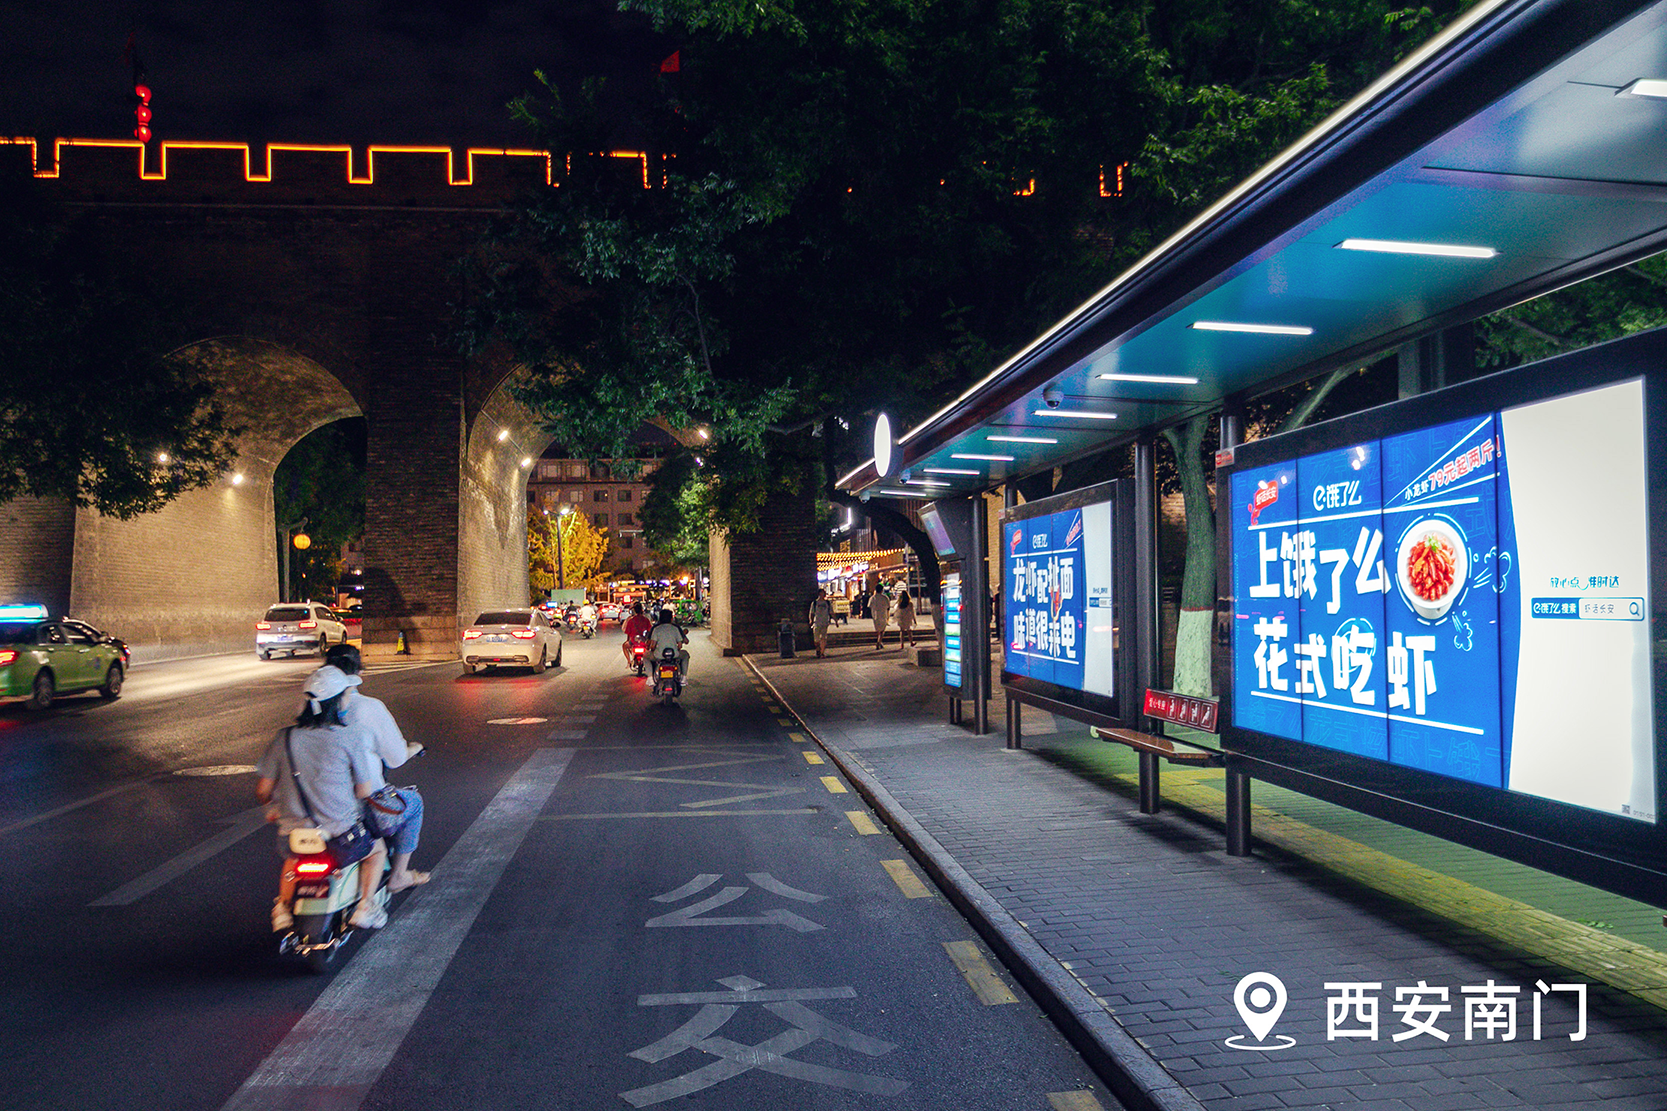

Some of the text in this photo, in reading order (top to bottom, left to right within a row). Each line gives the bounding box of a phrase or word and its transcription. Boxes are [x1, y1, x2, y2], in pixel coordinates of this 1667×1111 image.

[1012, 555, 1074, 604] 龙虾配扯面
[1249, 525, 1391, 615] 上饿了么
[1013, 608, 1077, 659] 味道很来电
[1253, 617, 1438, 717] 花式吃虾
